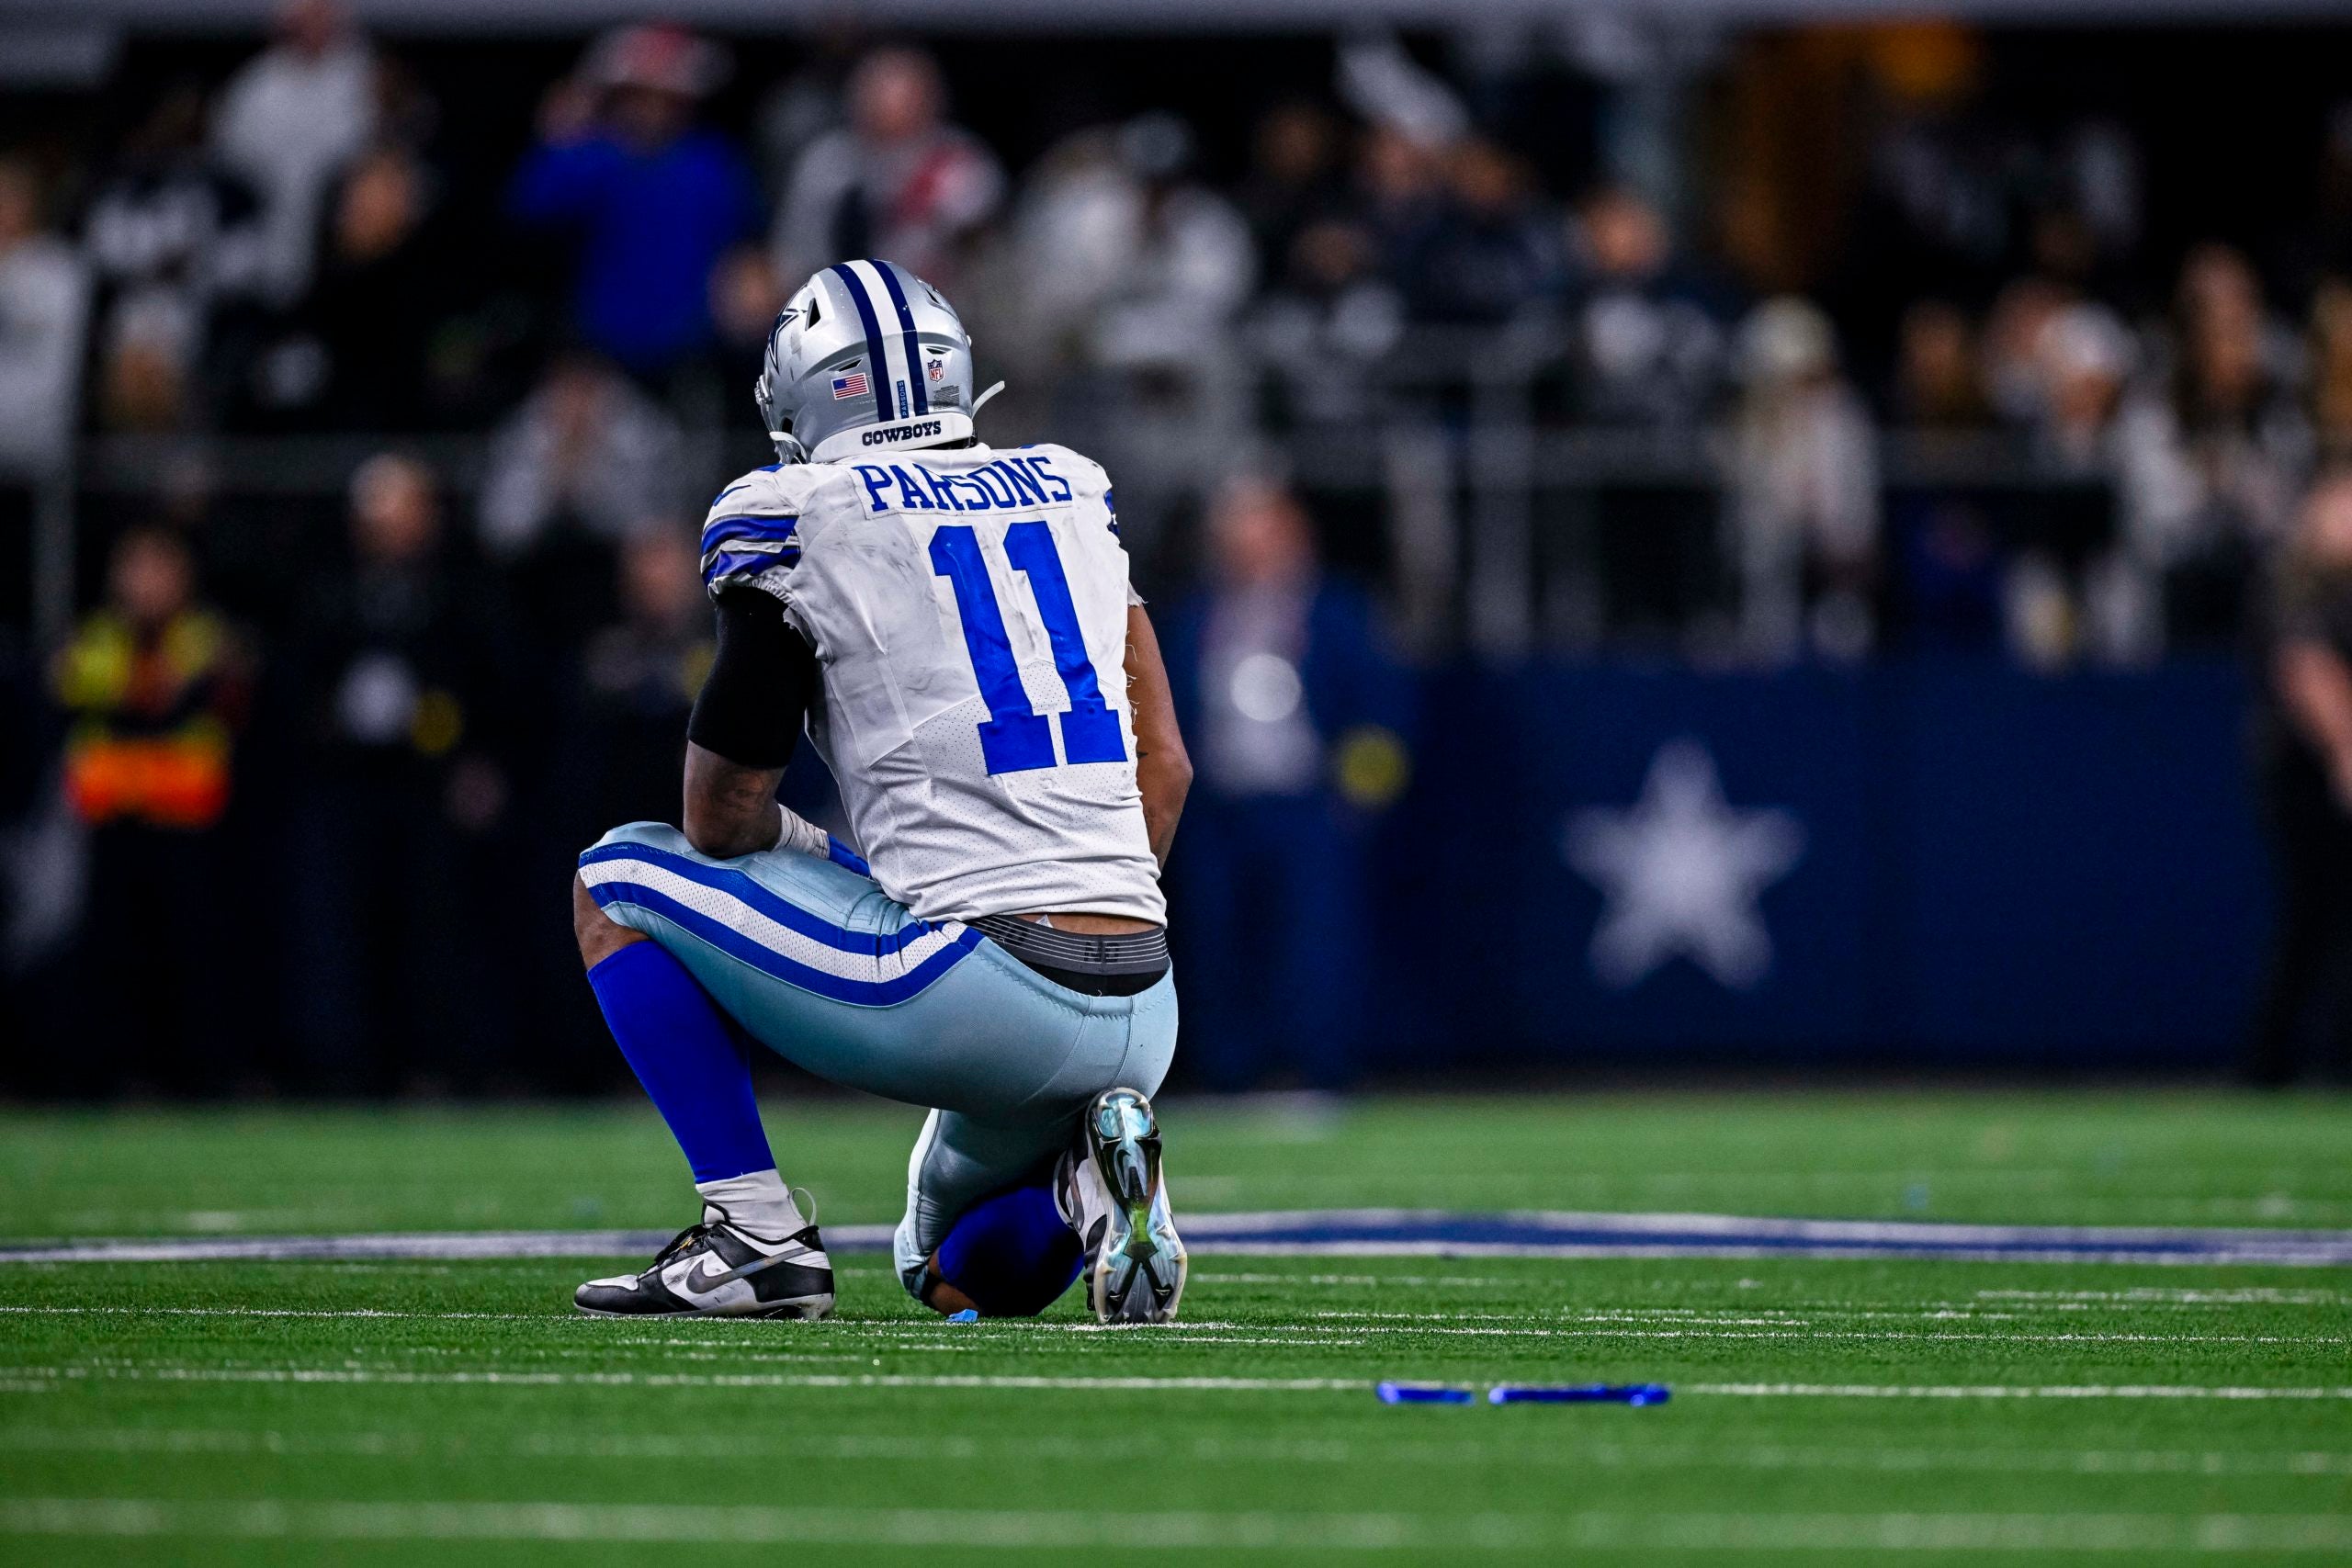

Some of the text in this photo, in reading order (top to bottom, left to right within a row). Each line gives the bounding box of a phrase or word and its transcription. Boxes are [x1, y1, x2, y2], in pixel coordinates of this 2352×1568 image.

[930, 368, 942, 379] NFL
[898, 381, 908, 416] PARSONS
[862, 421, 942, 446] COWBOYS
[852, 457, 1073, 512] PARSONS
[928, 520, 1128, 775] 11
